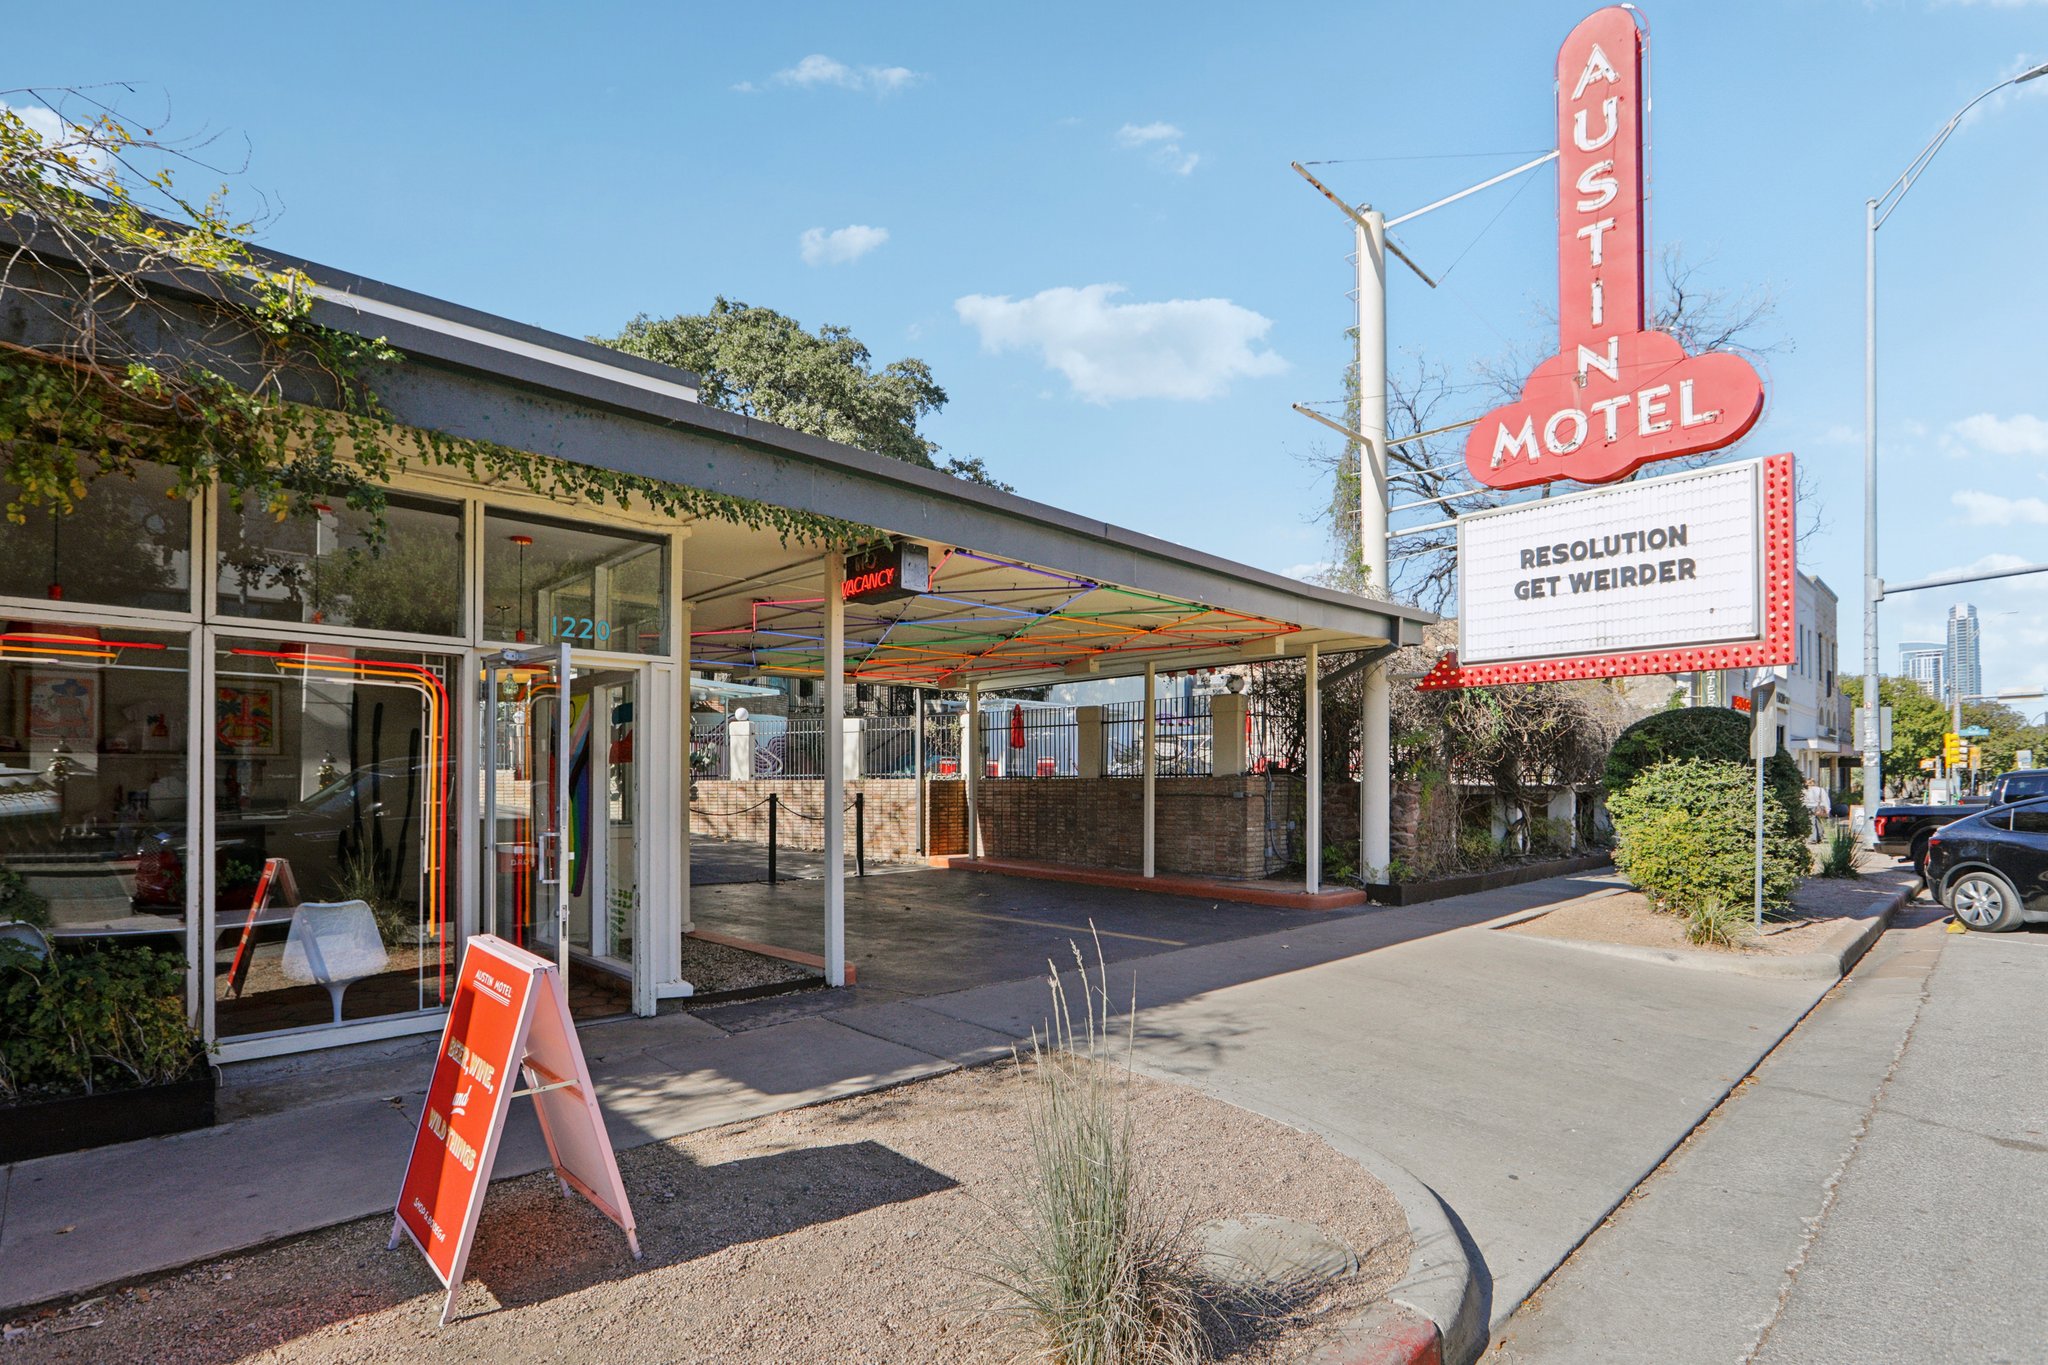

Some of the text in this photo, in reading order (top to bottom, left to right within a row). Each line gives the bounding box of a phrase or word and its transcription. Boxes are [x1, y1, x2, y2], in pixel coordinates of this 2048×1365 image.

[1571, 43, 1621, 388] AUSTIN
[1490, 378, 1724, 469] MOTEL
[1520, 523, 1688, 570] RESOLUTION
[841, 567, 895, 600] VACANCY
[1514, 557, 1697, 601] GET WEIRDER
[552, 615, 611, 641] 1220
[475, 969, 512, 998] AUSTIN MOTEL
[469, 1052, 495, 1095] WINE,
[451, 1085, 473, 1107] and
[428, 1107, 477, 1172] WILD THINGS
[413, 1197, 426, 1215] SHOP
